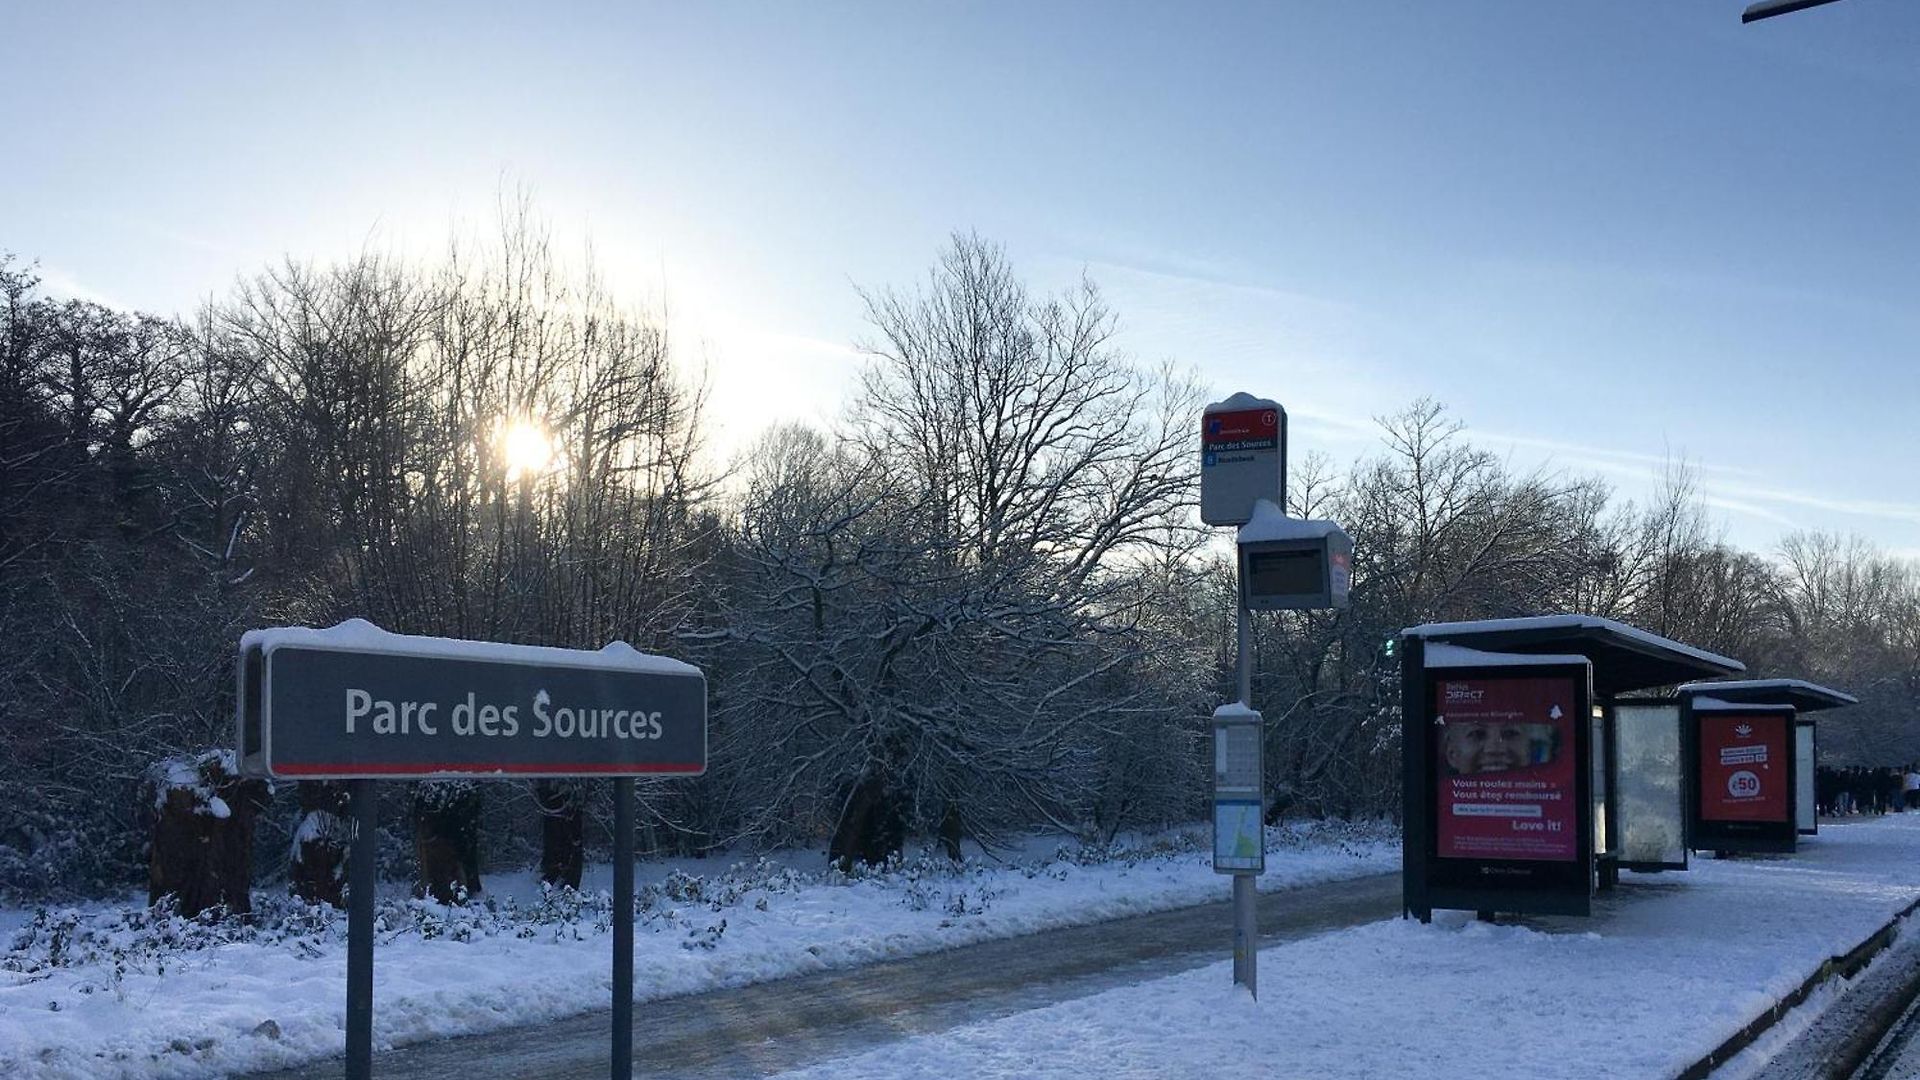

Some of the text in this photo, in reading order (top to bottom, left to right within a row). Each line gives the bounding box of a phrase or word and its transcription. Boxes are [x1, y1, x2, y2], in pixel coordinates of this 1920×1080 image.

[1209, 438, 1272, 451] Parc des Sources
[345, 688, 663, 740] Parc des Sources
[1453, 779, 1478, 788] Vous
[1515, 782, 1547, 790] moins
[1453, 790, 1478, 799] Vous
[1505, 792, 1562, 801] remboursé
[1512, 820, 1561, 832] Love it!
